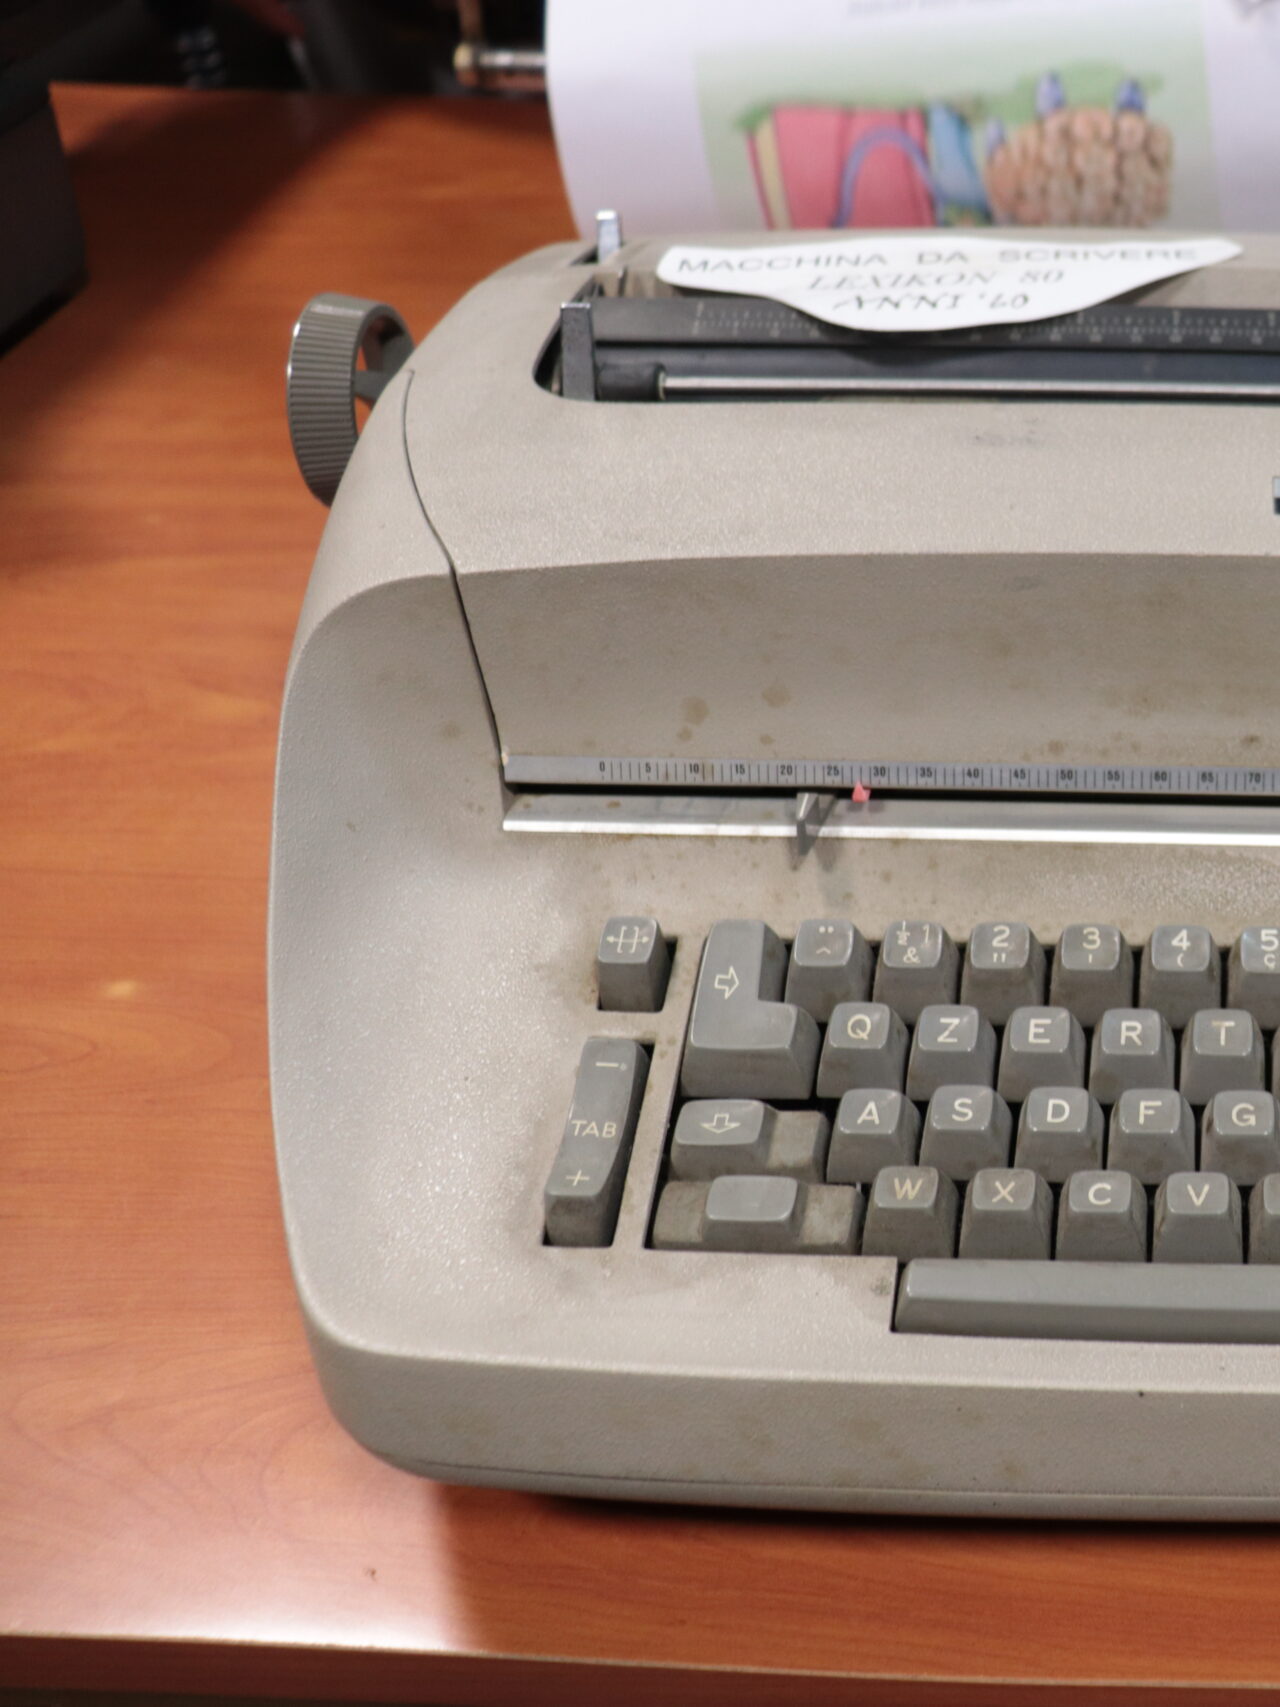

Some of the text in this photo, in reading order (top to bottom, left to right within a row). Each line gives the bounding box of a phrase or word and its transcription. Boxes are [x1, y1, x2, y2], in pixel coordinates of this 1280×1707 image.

[677, 248, 1197, 272] MACCHINA DA SCRIVERE
[808, 269, 1065, 290] LEXIKON 80
[832, 293, 963, 310] ANNI
[600, 762, 605, 772] 0
[645, 763, 651, 773] 5
[689, 764, 699, 774] 10
[736, 765, 745, 774] 15
[780, 765, 793, 776] 20
[827, 765, 840, 776] 25
[873, 766, 886, 777] 30
[920, 767, 933, 778] 35
[966, 767, 980, 778] 40
[1013, 768, 1026, 779] 45
[1060, 769, 1073, 780] 50
[1107, 770, 1120, 781] 55
[1154, 771, 1167, 782] 60
[1201, 772, 1214, 783] 65
[1249, 773, 1261, 784] 70
[922, 924, 931, 944] 1
[992, 926, 1009, 947] 2
[1084, 928, 1100, 949] 3
[1172, 930, 1190, 950] 4
[1261, 930, 1278, 951] 5
[903, 948, 921, 964] &
[848, 1014, 871, 1039] Q
[938, 1018, 960, 1042] Z
[1029, 1019, 1051, 1043] E
[1121, 1021, 1141, 1044] R
[1213, 1021, 1235, 1045] T
[858, 1102, 879, 1124] A
[953, 1098, 972, 1121] S
[1047, 1099, 1069, 1122] D
[1139, 1101, 1162, 1124] F
[1232, 1103, 1255, 1126] G
[572, 1120, 616, 1137] TAB
[895, 1178, 922, 1199] W
[992, 1181, 1015, 1202] X
[1089, 1183, 1111, 1204] C
[1188, 1184, 1209, 1205] V
